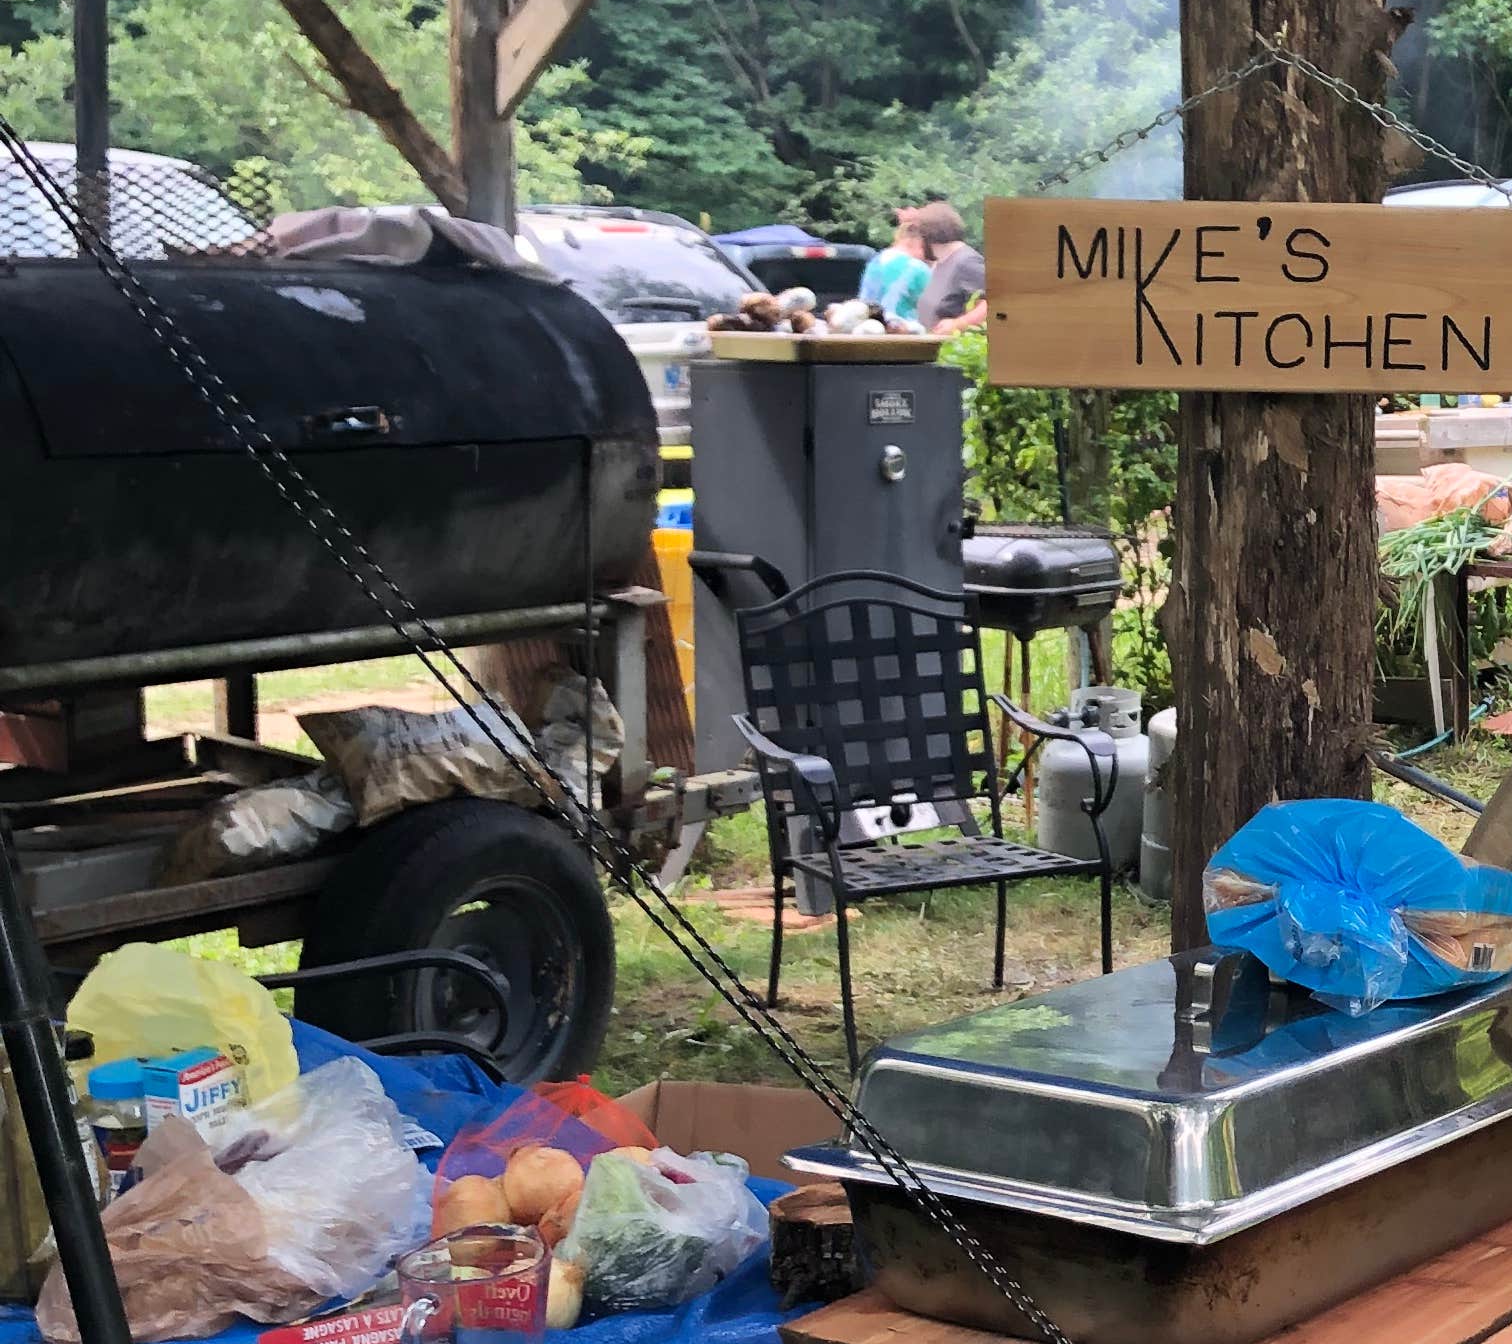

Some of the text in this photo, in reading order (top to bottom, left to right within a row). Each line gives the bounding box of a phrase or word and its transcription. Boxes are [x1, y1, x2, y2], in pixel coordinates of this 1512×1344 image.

[1135, 226, 1491, 372] KITCHEN
[184, 1079, 240, 1112] JIFFY
[302, 1316, 359, 1341] LASAGNE
